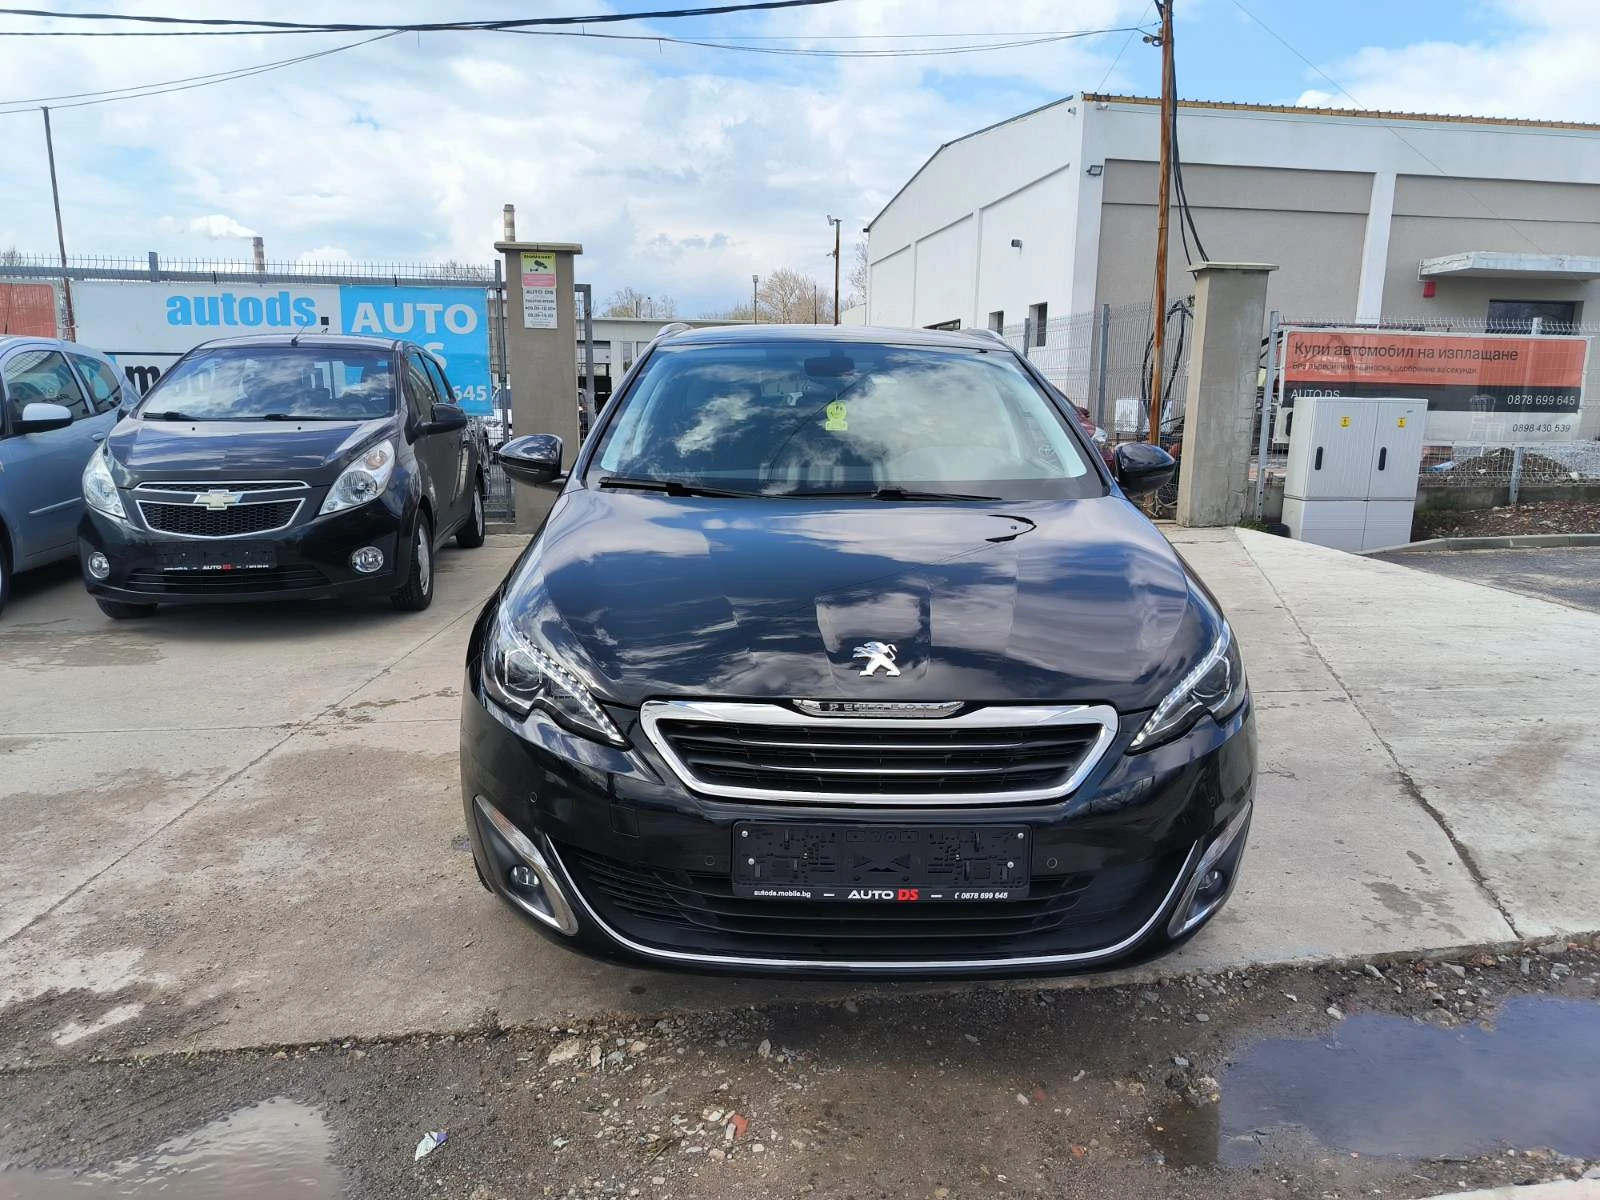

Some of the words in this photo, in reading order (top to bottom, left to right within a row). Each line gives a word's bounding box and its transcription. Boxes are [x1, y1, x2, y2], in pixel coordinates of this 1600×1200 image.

[351, 302, 478, 335] AUTO
[1294, 341, 1330, 358] Купи
[1334, 344, 1414, 357] автомобил
[1418, 348, 1434, 358] на
[1438, 349, 1518, 361] изплащане
[1507, 395, 1533, 405] 0878
[1535, 395, 1555, 405] 699
[1557, 395, 1576, 406] 645
[1512, 423, 1535, 433] 0898
[1536, 424, 1552, 433] 430
[1555, 424, 1571, 433] 539
[828, 702, 932, 712] PEUGEOT
[848, 890, 894, 899] AUTO
[898, 889, 919, 901] DS
